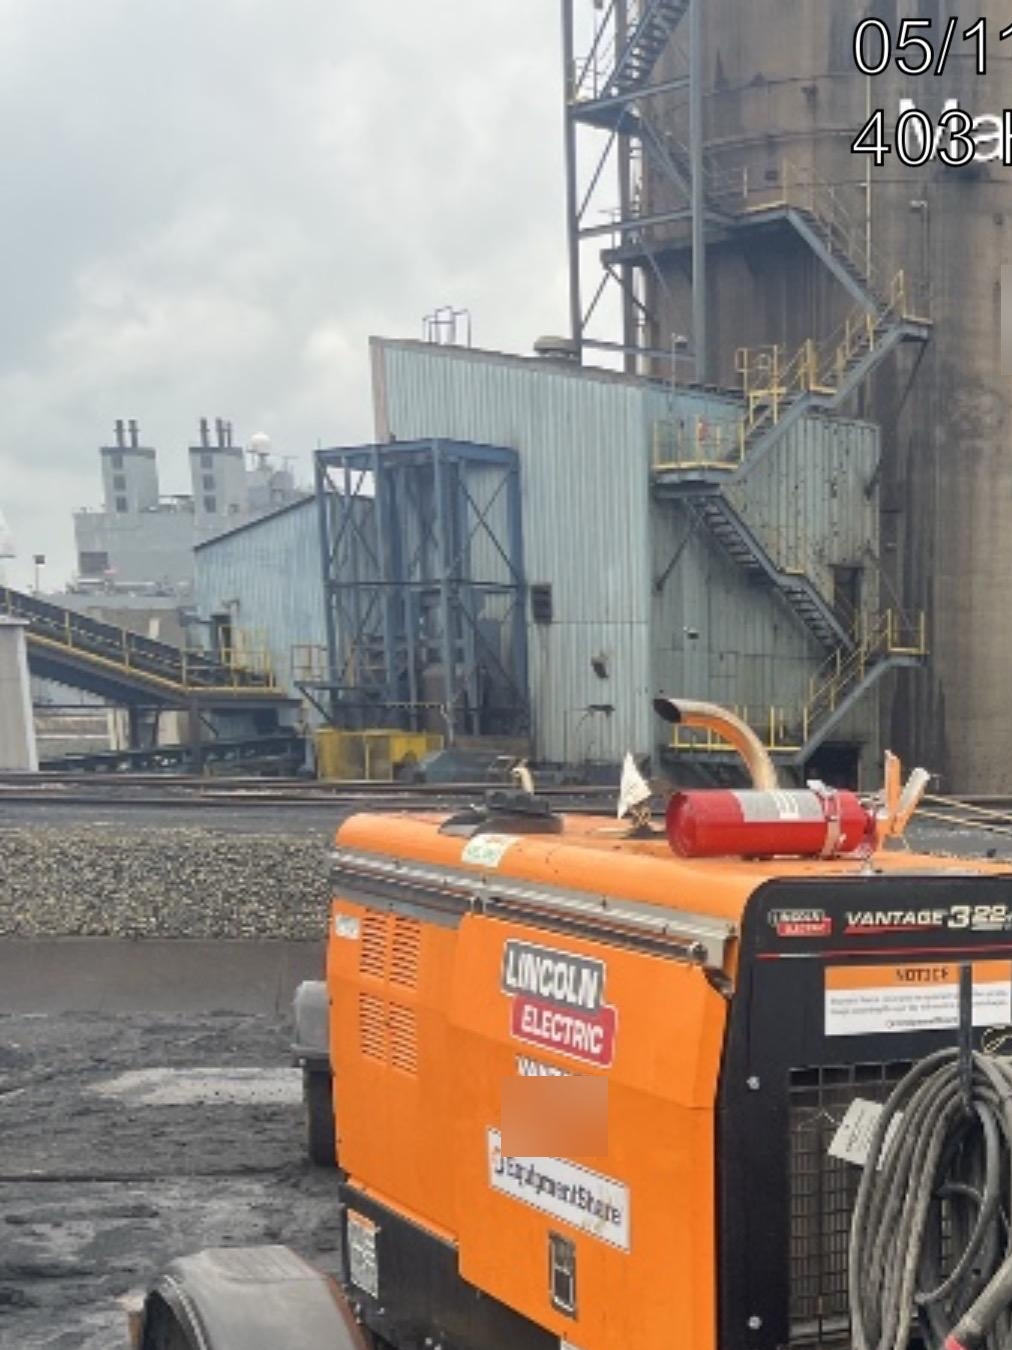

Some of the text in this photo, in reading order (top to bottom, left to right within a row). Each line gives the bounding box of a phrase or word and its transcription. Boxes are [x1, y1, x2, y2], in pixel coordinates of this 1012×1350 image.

[845, 910, 947, 926] VANTAGE
[506, 950, 598, 1009] LINCOLN
[521, 1004, 603, 1054] ELECTRIC
[506, 1157, 622, 1226] EquipmentShare
